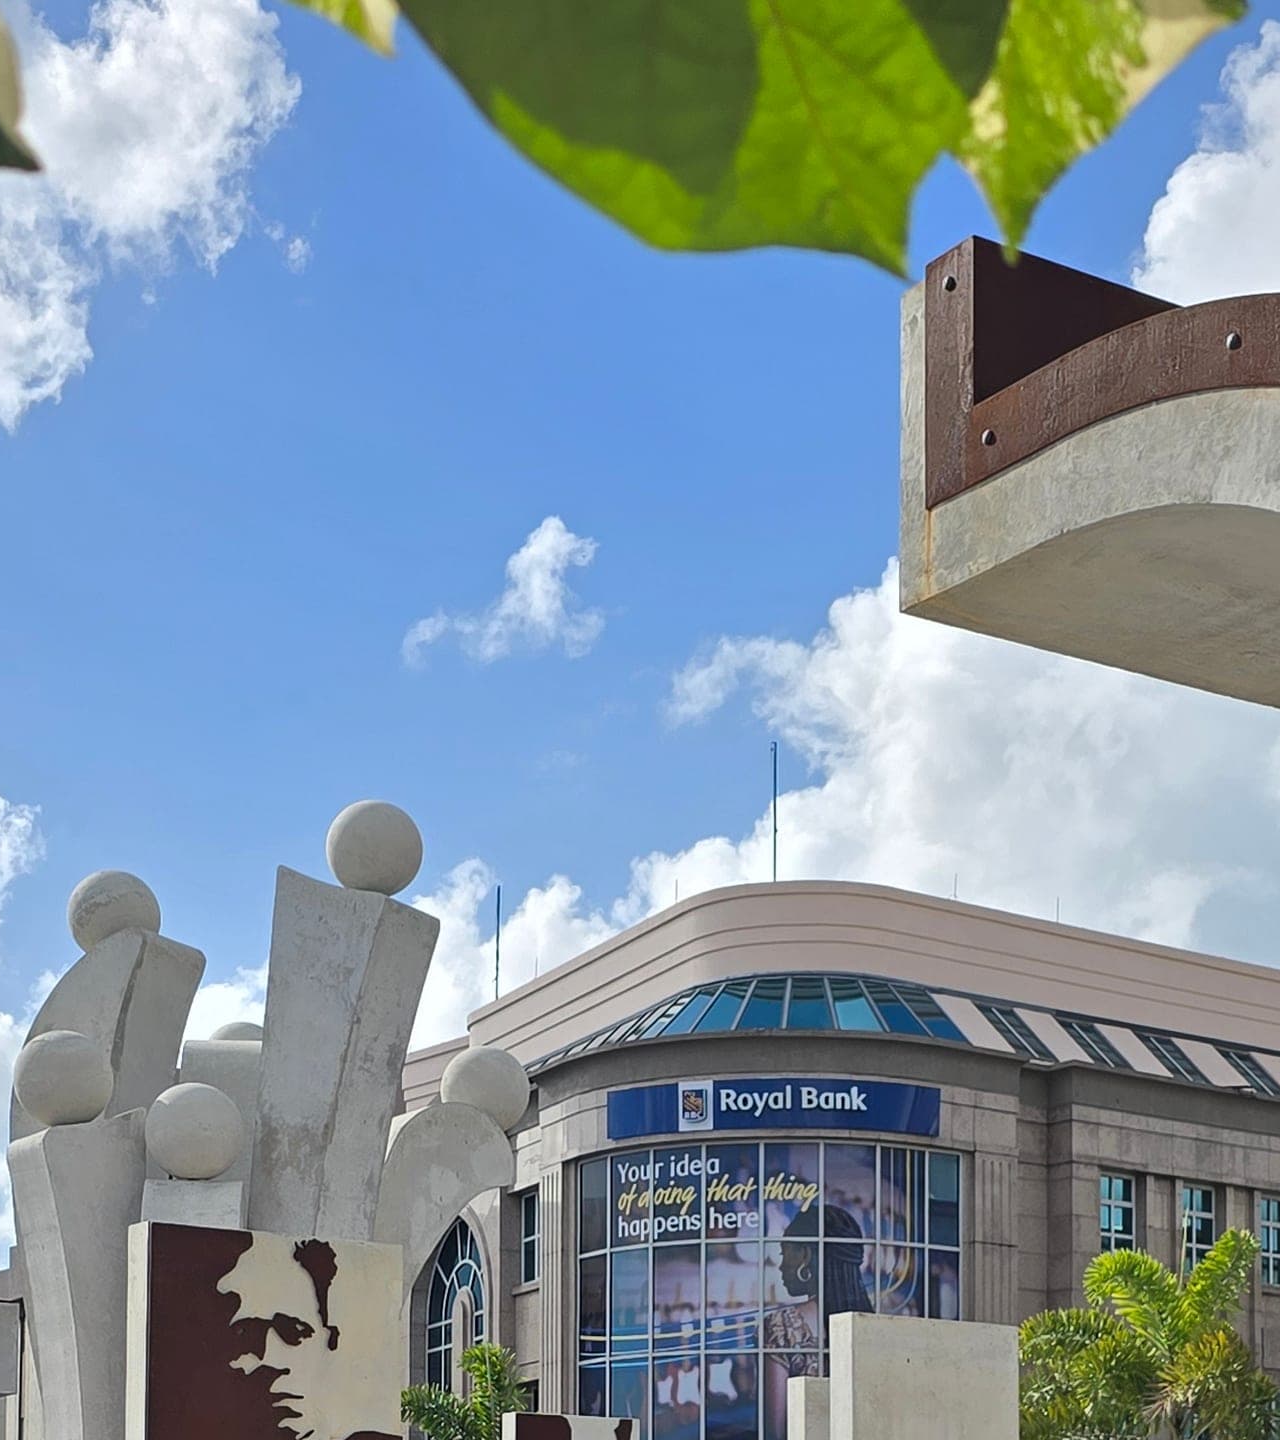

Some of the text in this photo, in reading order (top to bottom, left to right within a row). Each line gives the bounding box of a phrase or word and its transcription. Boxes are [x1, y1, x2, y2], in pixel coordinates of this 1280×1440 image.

[720, 1085, 868, 1117] Royal Bank
[616, 1153, 720, 1184] Your idea
[617, 1172, 820, 1217] of doing that thing
[617, 1207, 760, 1243] happens here
